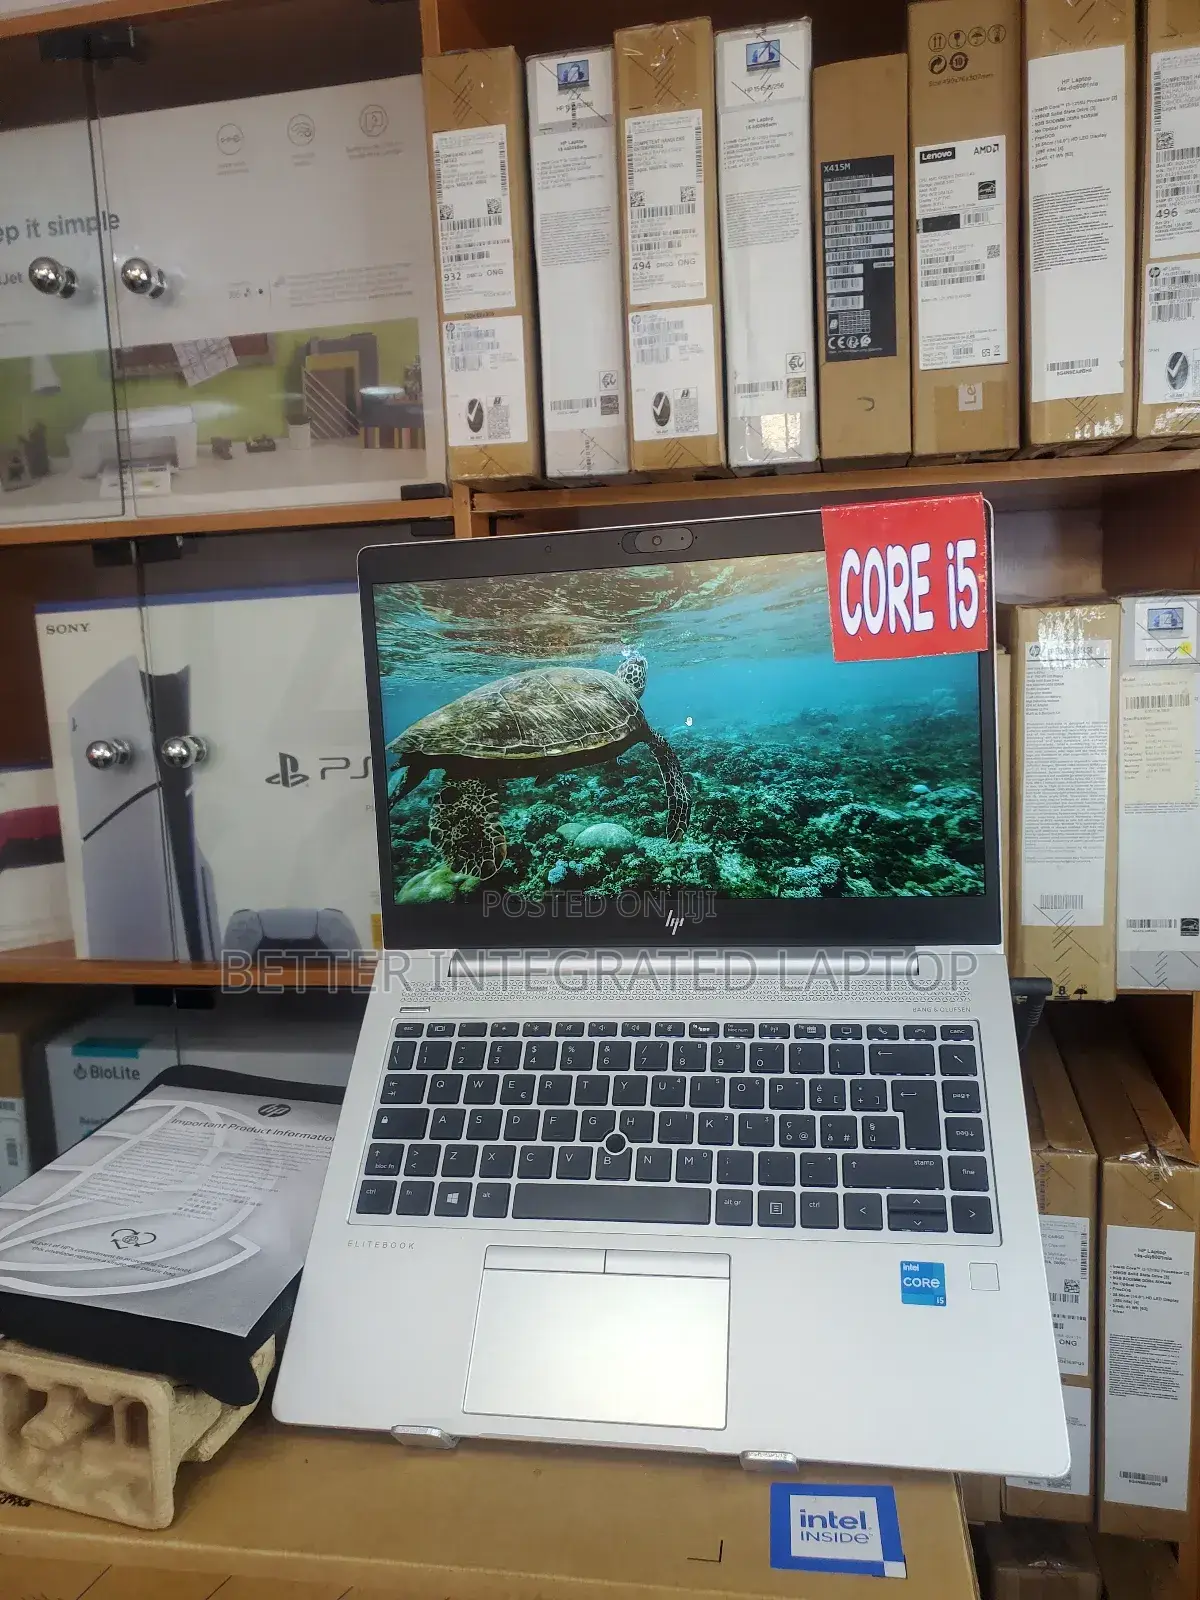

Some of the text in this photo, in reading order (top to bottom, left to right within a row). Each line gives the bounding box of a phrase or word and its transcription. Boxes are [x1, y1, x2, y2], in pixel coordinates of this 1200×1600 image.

[922, 146, 992, 161] Lenovo AMD
[823, 163, 851, 173] X415M
[1156, 208, 1179, 219] 496
[25, 217, 41, 239] it
[48, 210, 120, 237] simple
[632, 261, 652, 271] 494
[677, 258, 696, 266] ONG
[444, 272, 462, 282] 932
[486, 268, 504, 276] ONG
[840, 538, 980, 636] CORE i5
[46, 622, 91, 636] SONY
[89, 1064, 140, 1080] BioLite
[436, 1080, 445, 1089] Q
[473, 1080, 484, 1088] W
[508, 1080, 516, 1088] E
[545, 1080, 552, 1089] R
[620, 1082, 628, 1090] Y
[658, 1082, 666, 1090] U
[737, 1084, 746, 1092] O
[776, 1084, 784, 1092] P
[171, 1118, 229, 1130] Important
[228, 1123, 272, 1135] Product
[438, 1116, 447, 1124] A
[476, 1116, 482, 1124] S
[512, 1116, 520, 1124] D
[588, 1117, 597, 1125] G
[626, 1118, 634, 1126] H
[666, 1118, 672, 1127] J
[706, 1120, 714, 1128] K
[746, 1120, 752, 1130] L
[799, 1132, 809, 1140] @
[844, 1134, 850, 1142] #
[450, 1152, 935, 1167] Z X C V B N M stamp
[724, 1198, 733, 1206] alt
[347, 1240, 416, 1250] ELITEBOOK
[902, 1262, 920, 1272] intel
[936, 1296, 944, 1304] i5
[1058, 1338, 1078, 1346] ONG
[799, 1508, 868, 1530] intel
